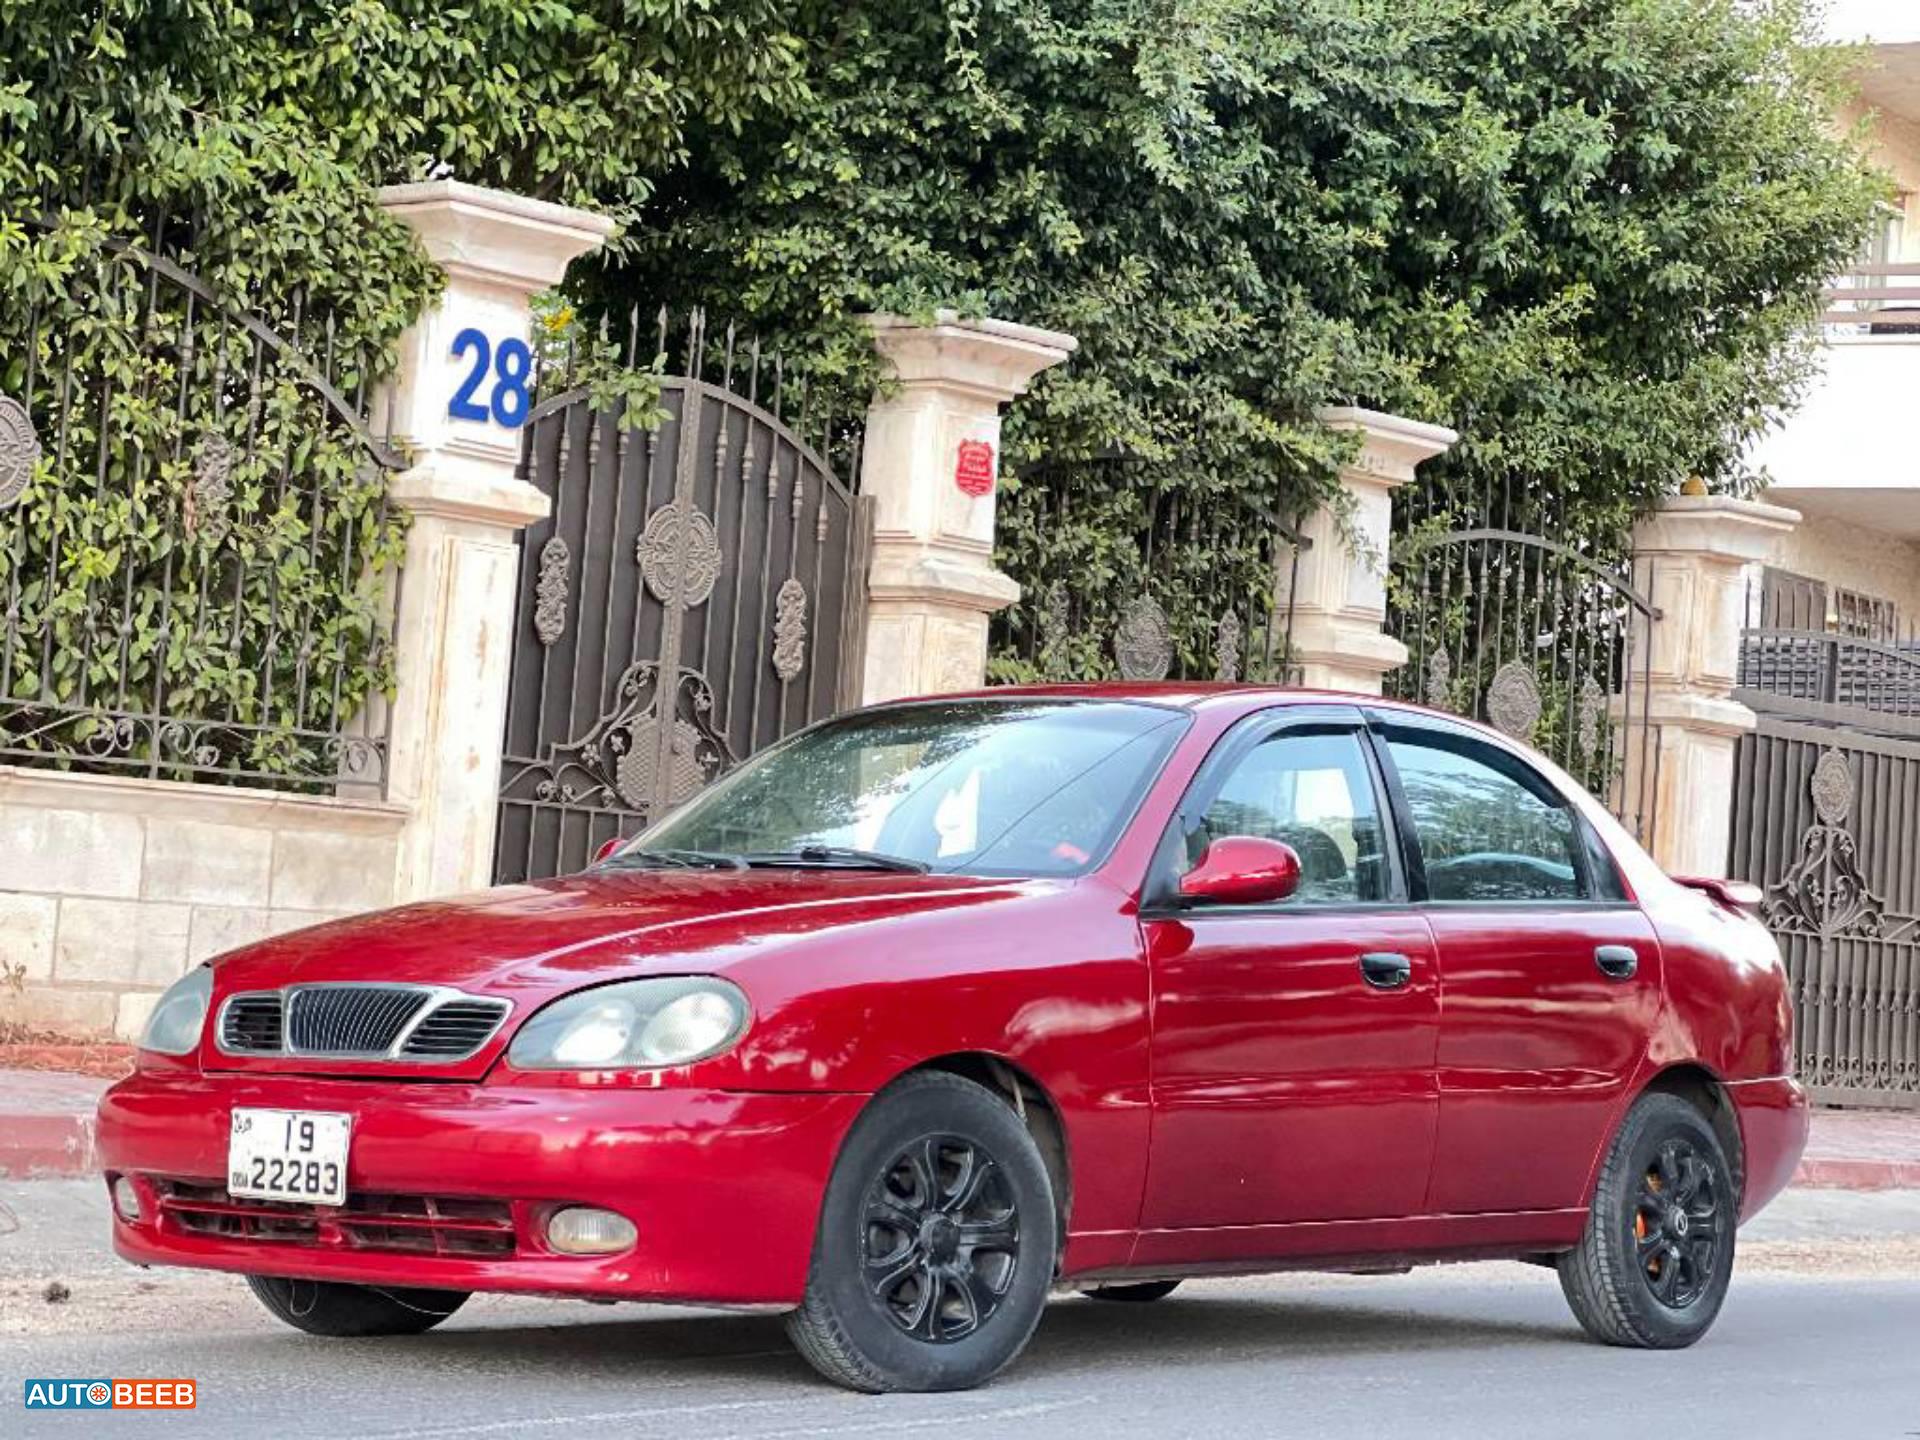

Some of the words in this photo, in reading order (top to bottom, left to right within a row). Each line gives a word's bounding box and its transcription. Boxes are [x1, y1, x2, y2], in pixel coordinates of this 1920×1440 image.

[448, 328, 531, 428] 28
[285, 1119, 314, 1152] 19
[251, 1157, 339, 1195] 22283
